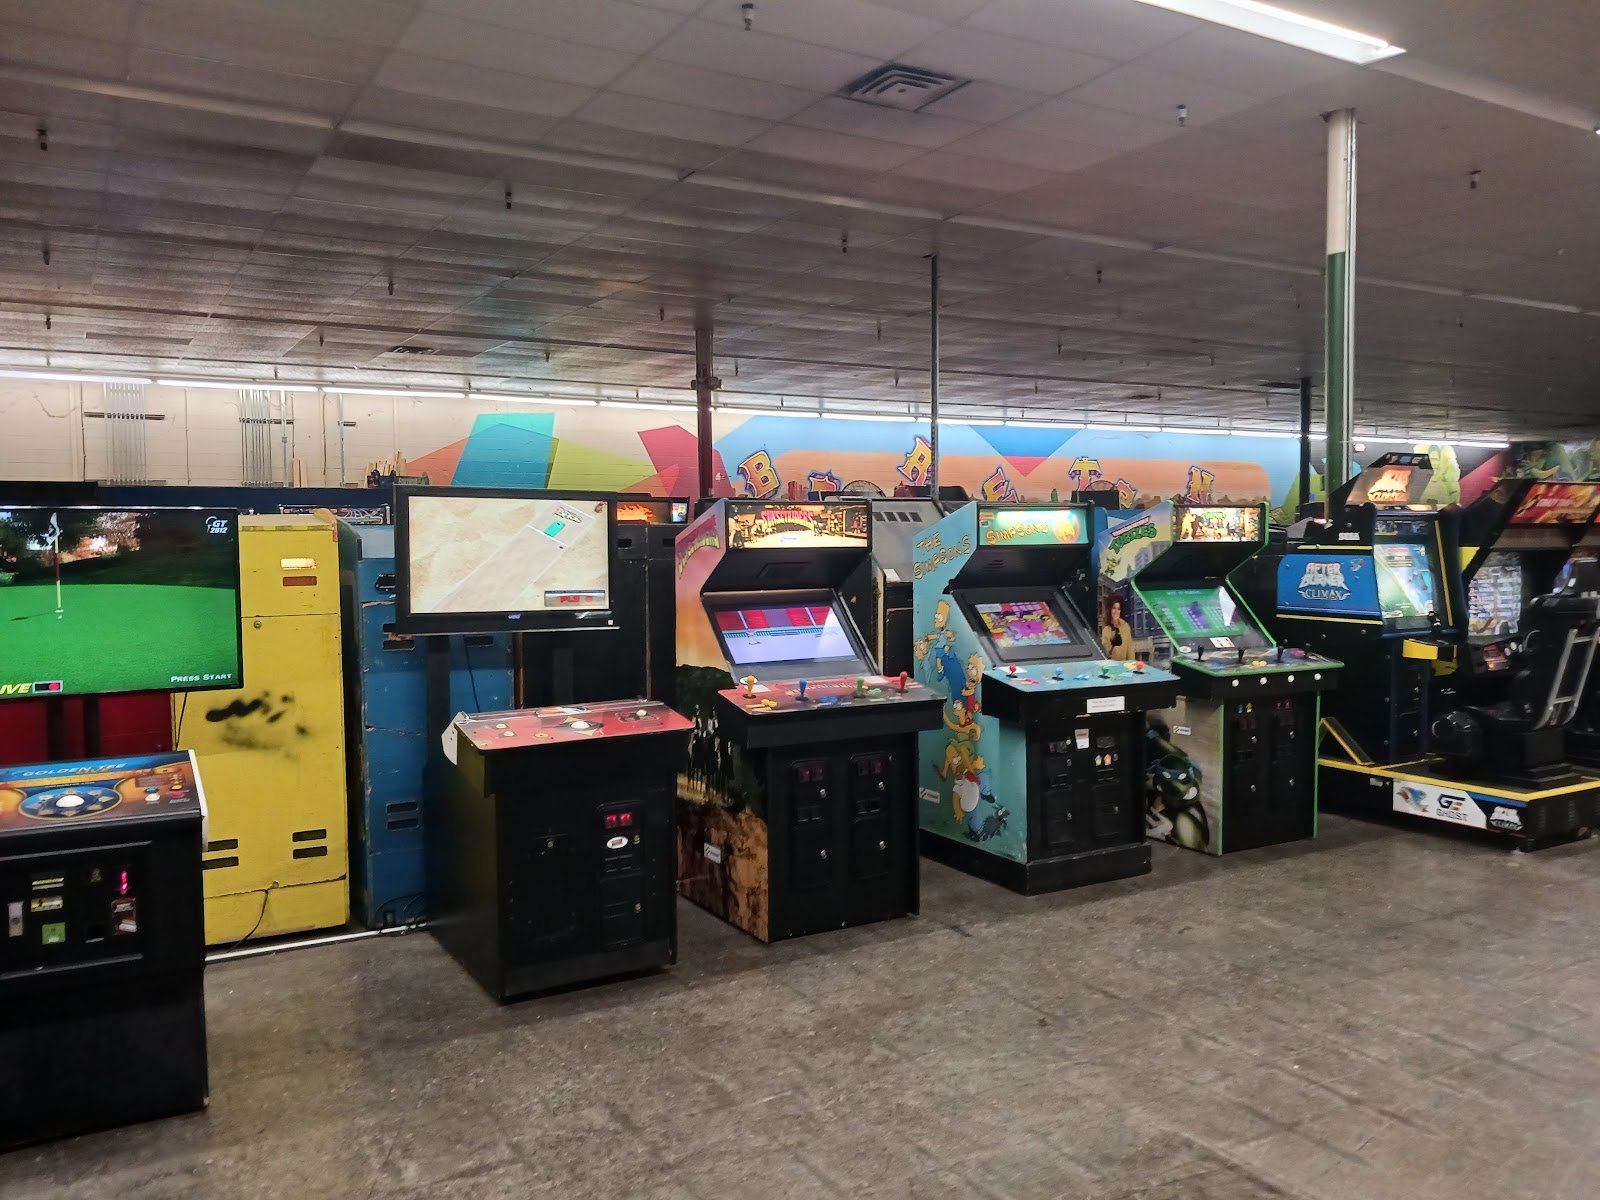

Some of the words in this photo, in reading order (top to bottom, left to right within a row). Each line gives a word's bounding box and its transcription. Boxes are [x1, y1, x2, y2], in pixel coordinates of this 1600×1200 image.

[737, 450, 780, 499] B
[212, 519, 228, 528] GT
[986, 521, 1049, 545] SIMPSONS
[171, 674, 200, 682] PRESS
[203, 673, 232, 681] START
[23, 766, 91, 777] GOLDEN
